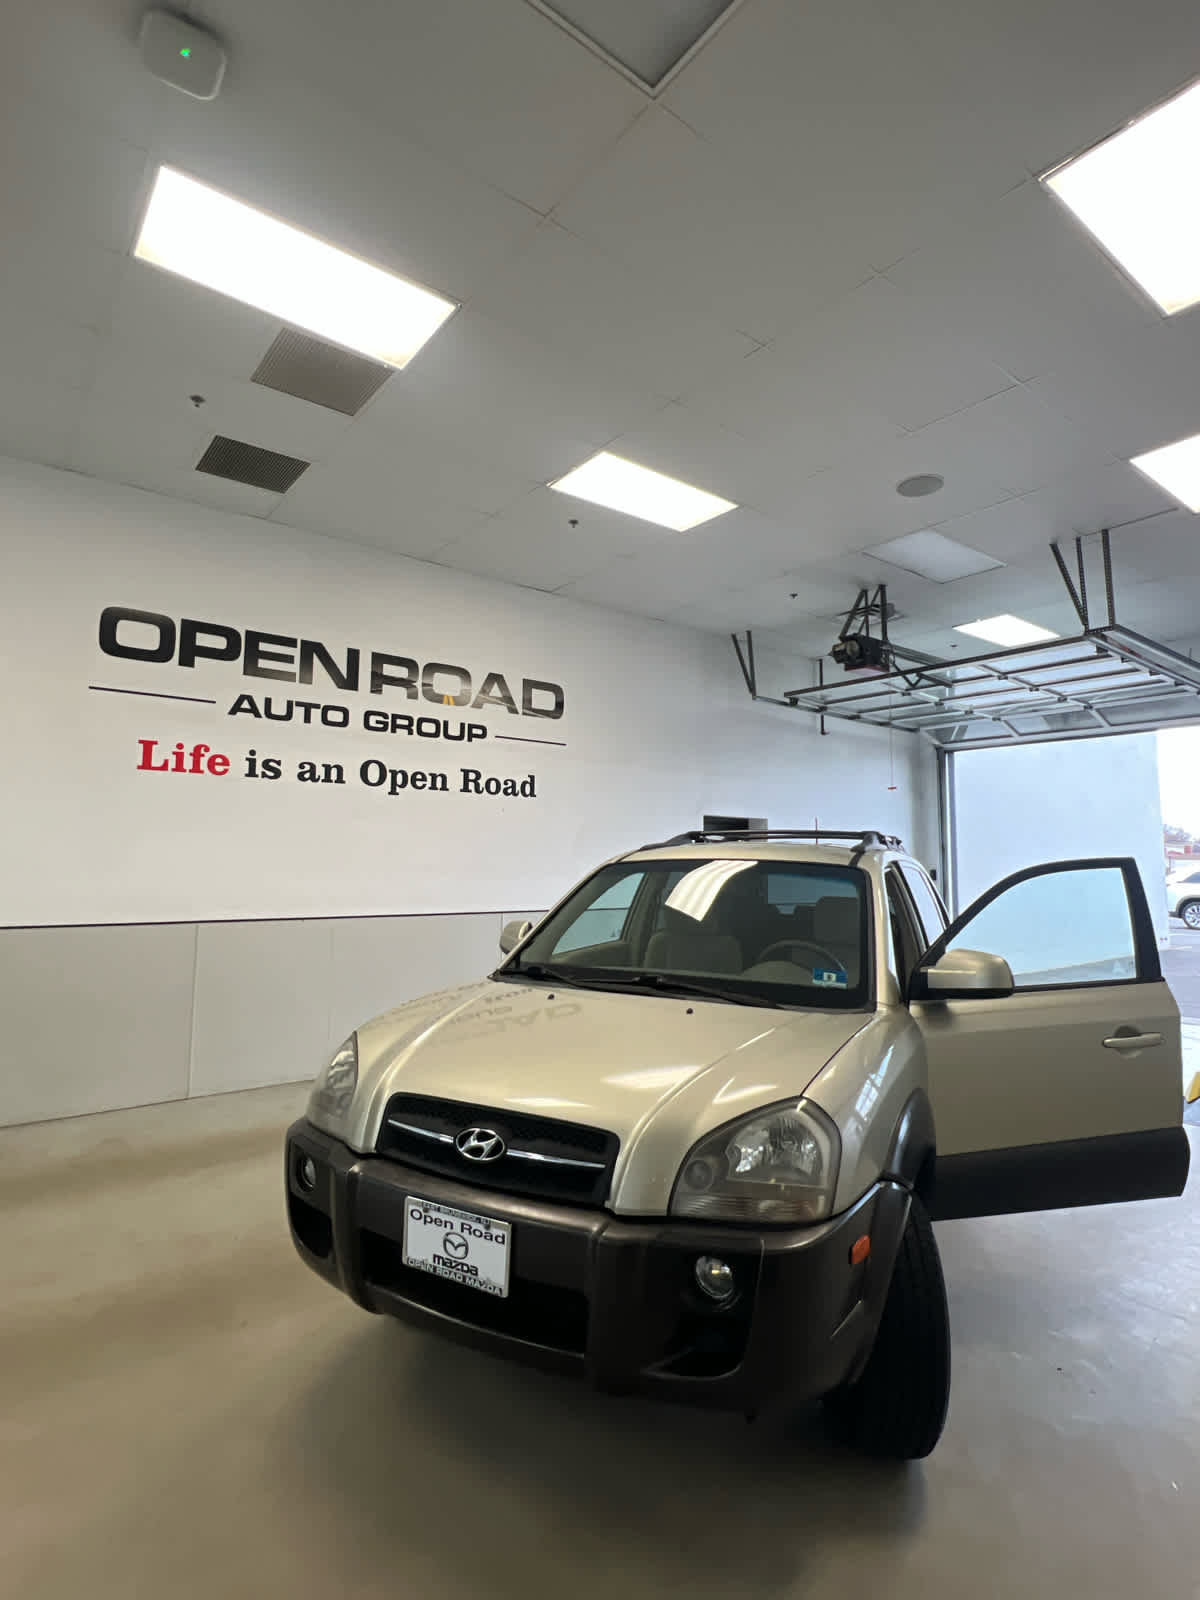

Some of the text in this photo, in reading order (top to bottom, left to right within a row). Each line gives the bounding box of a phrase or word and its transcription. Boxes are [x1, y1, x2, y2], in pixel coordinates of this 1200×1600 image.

[228, 694, 488, 743] AUTO GROUP
[137, 739, 537, 798] Life is an Open Road
[410, 1208, 454, 1231] Open
[460, 1221, 506, 1246] Road
